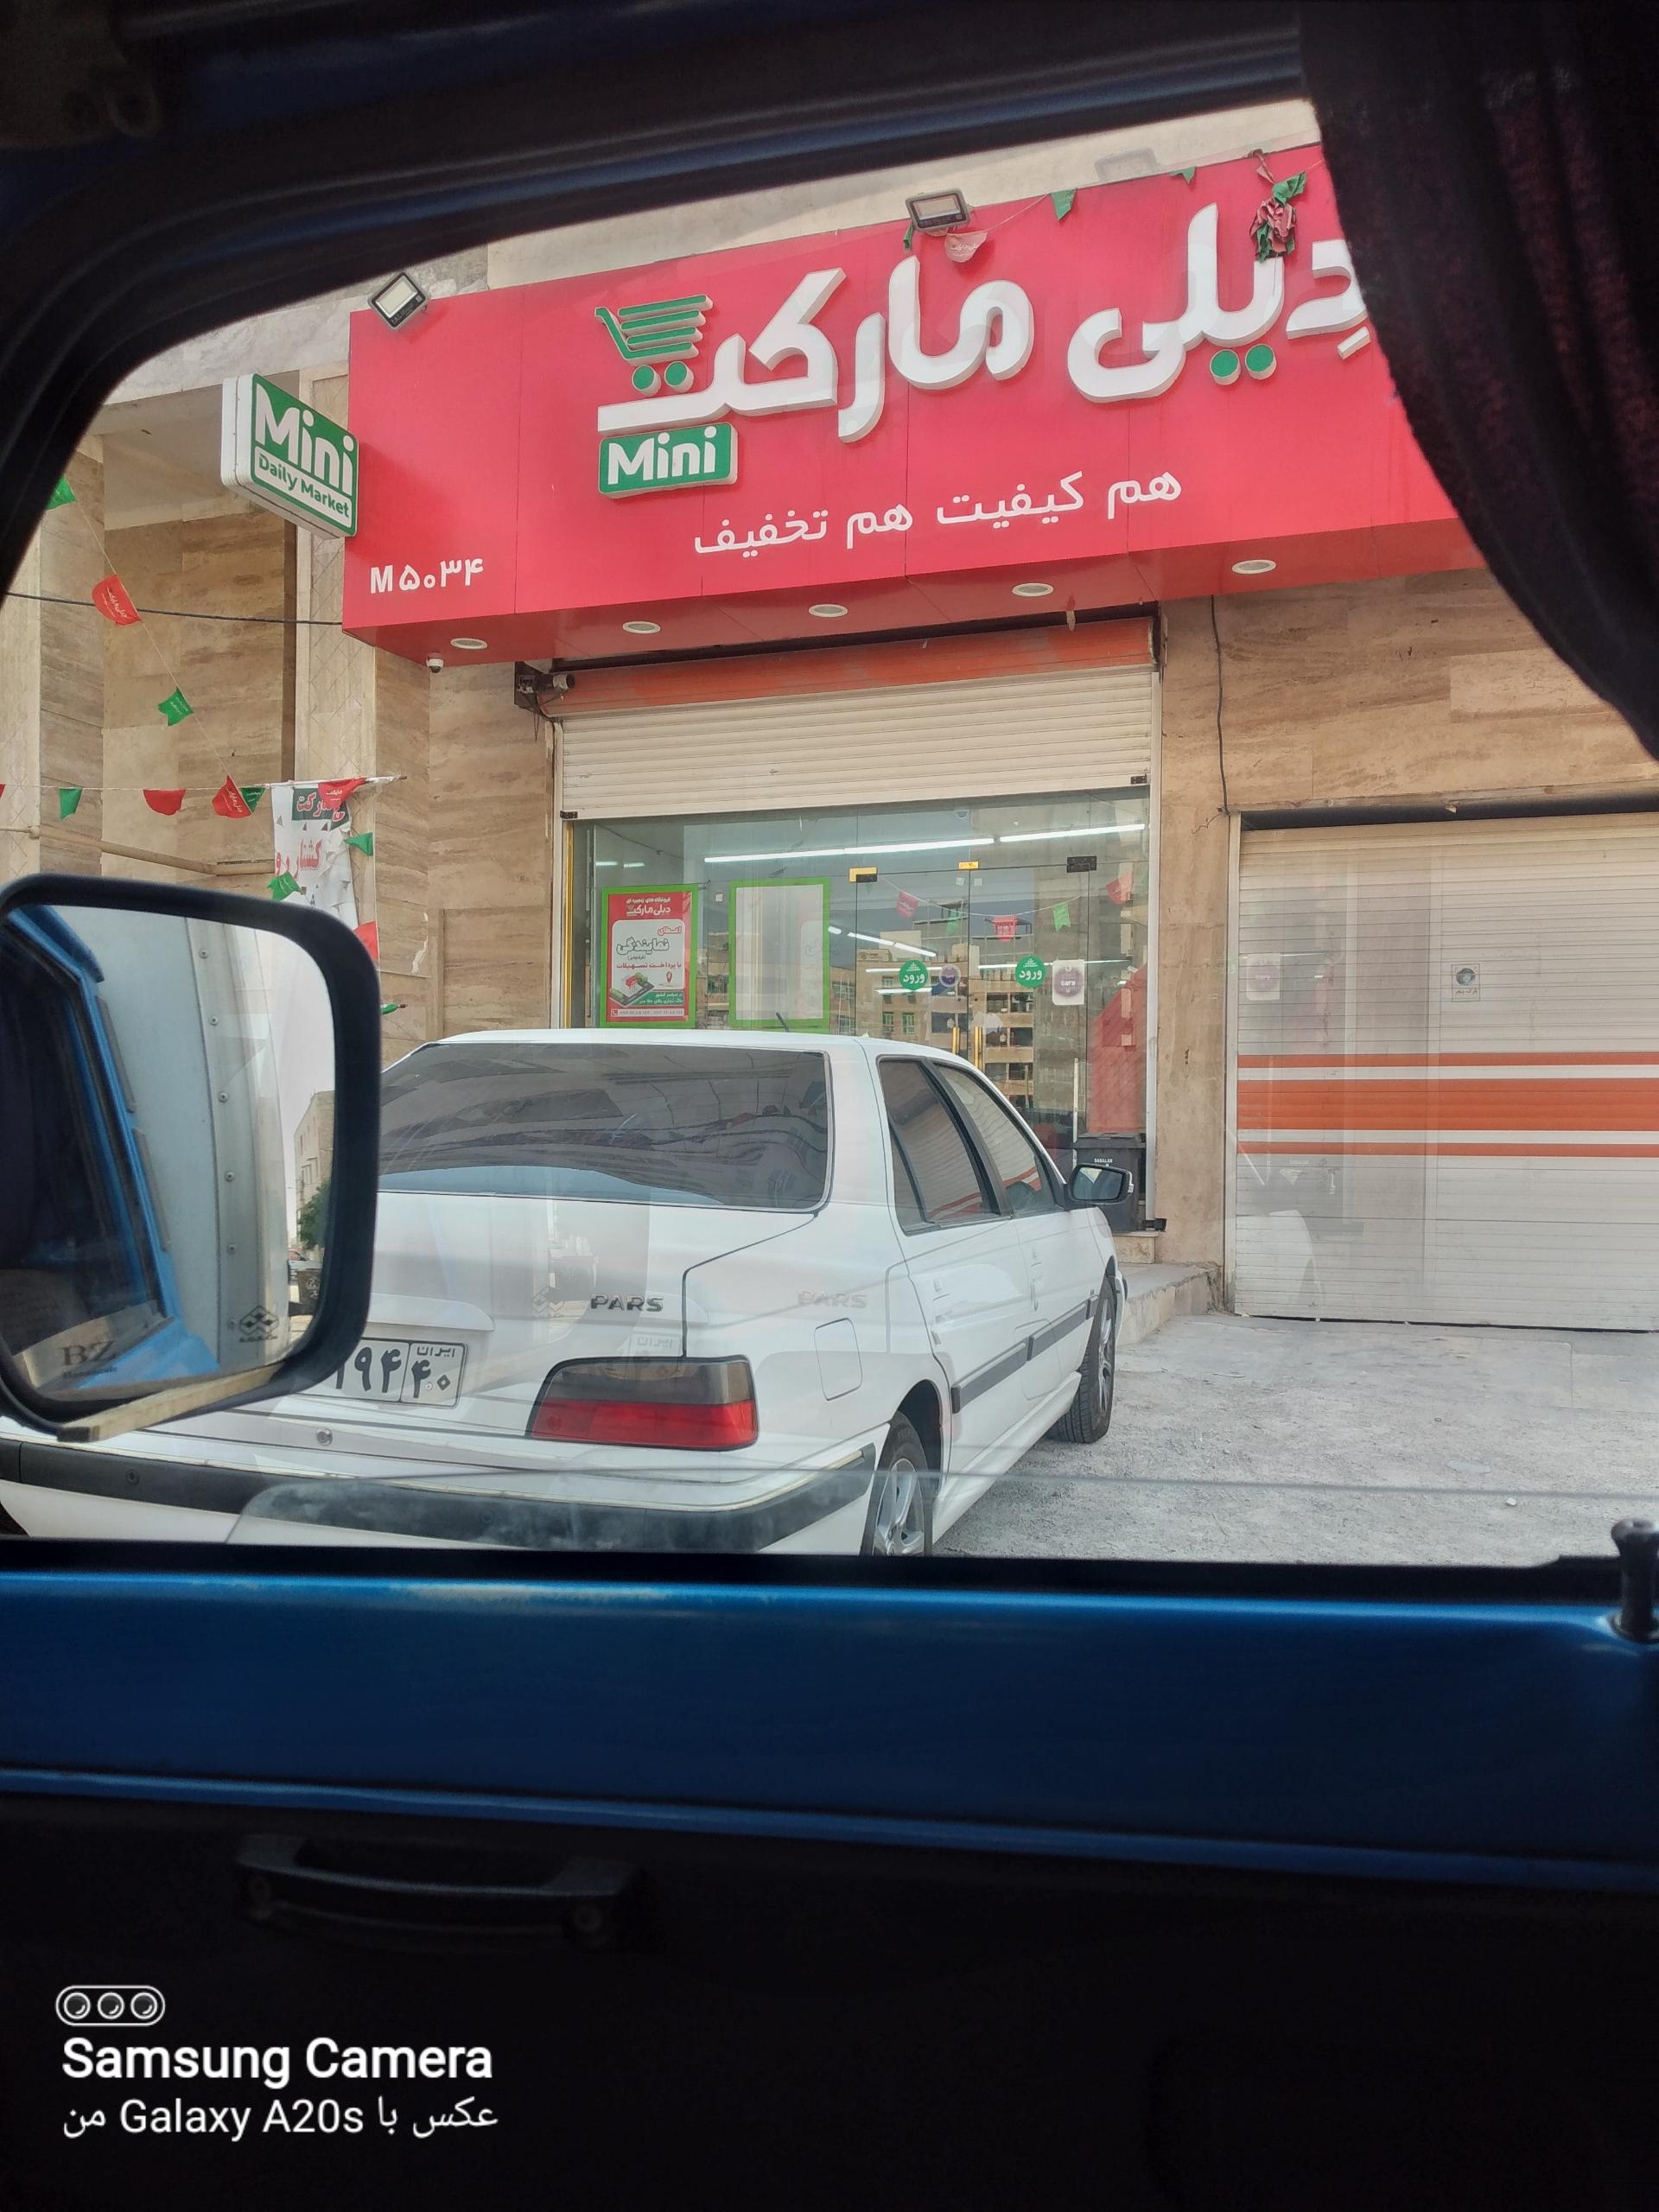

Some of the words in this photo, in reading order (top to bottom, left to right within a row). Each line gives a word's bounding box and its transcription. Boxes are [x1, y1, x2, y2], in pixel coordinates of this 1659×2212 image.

[597, 254, 1035, 443] مارکت
[256, 383, 354, 496] Mini
[607, 425, 717, 485] Mini
[258, 454, 298, 491] Daily
[301, 479, 350, 518] Market
[937, 470, 1084, 529] کیفیت
[1107, 472, 1182, 520] هم
[694, 509, 829, 558] تخفیف
[847, 504, 913, 550] هم
[903, 973, 925, 984] ورود
[1020, 969, 1043, 981] ورود
[590, 1293, 664, 1313] PARS
[416, 1345, 456, 1358] ایران
[410, 1359, 451, 1399] ۴۰
